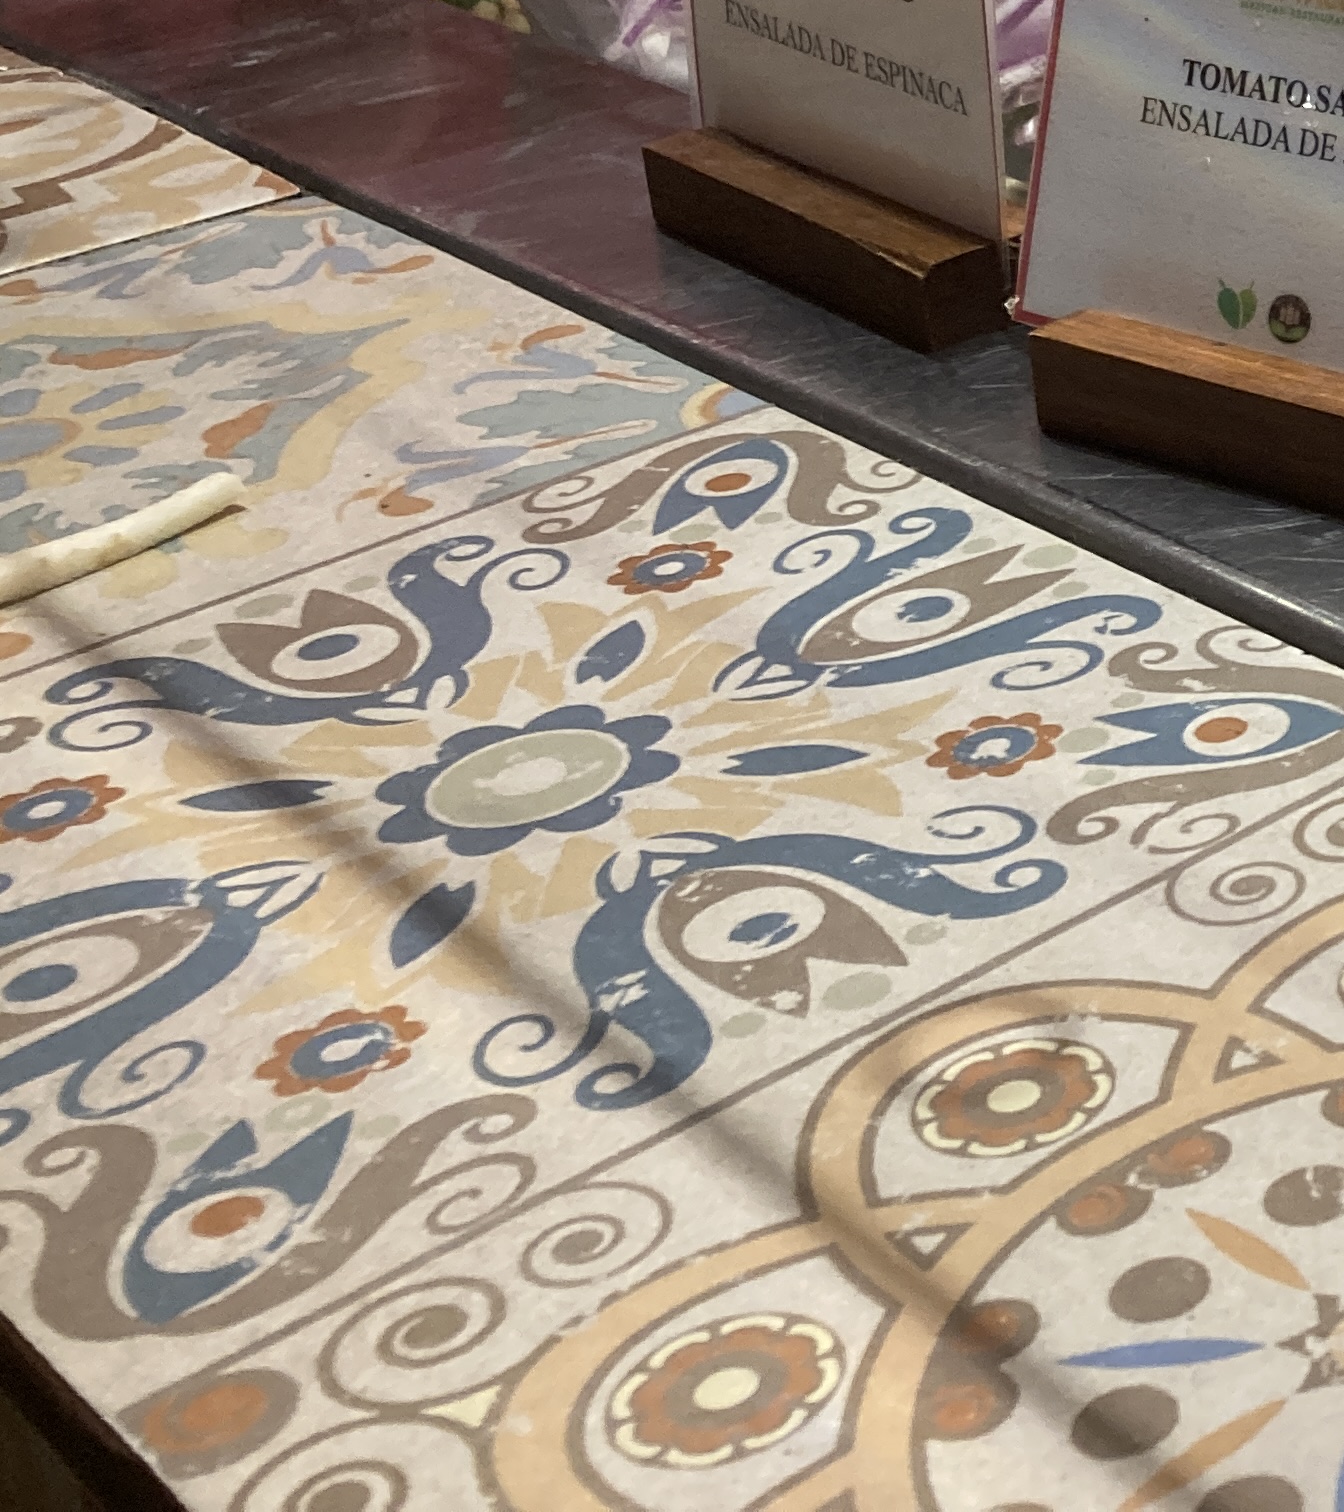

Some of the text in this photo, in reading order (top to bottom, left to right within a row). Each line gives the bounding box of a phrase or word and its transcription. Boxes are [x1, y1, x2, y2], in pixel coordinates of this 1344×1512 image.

[830, 38, 859, 74] DE
[863, 51, 968, 116] ESPINACA
[1182, 59, 1308, 109] TOMATO
[1139, 96, 1292, 154] ENSALADA
[1297, 128, 1338, 163] DE
